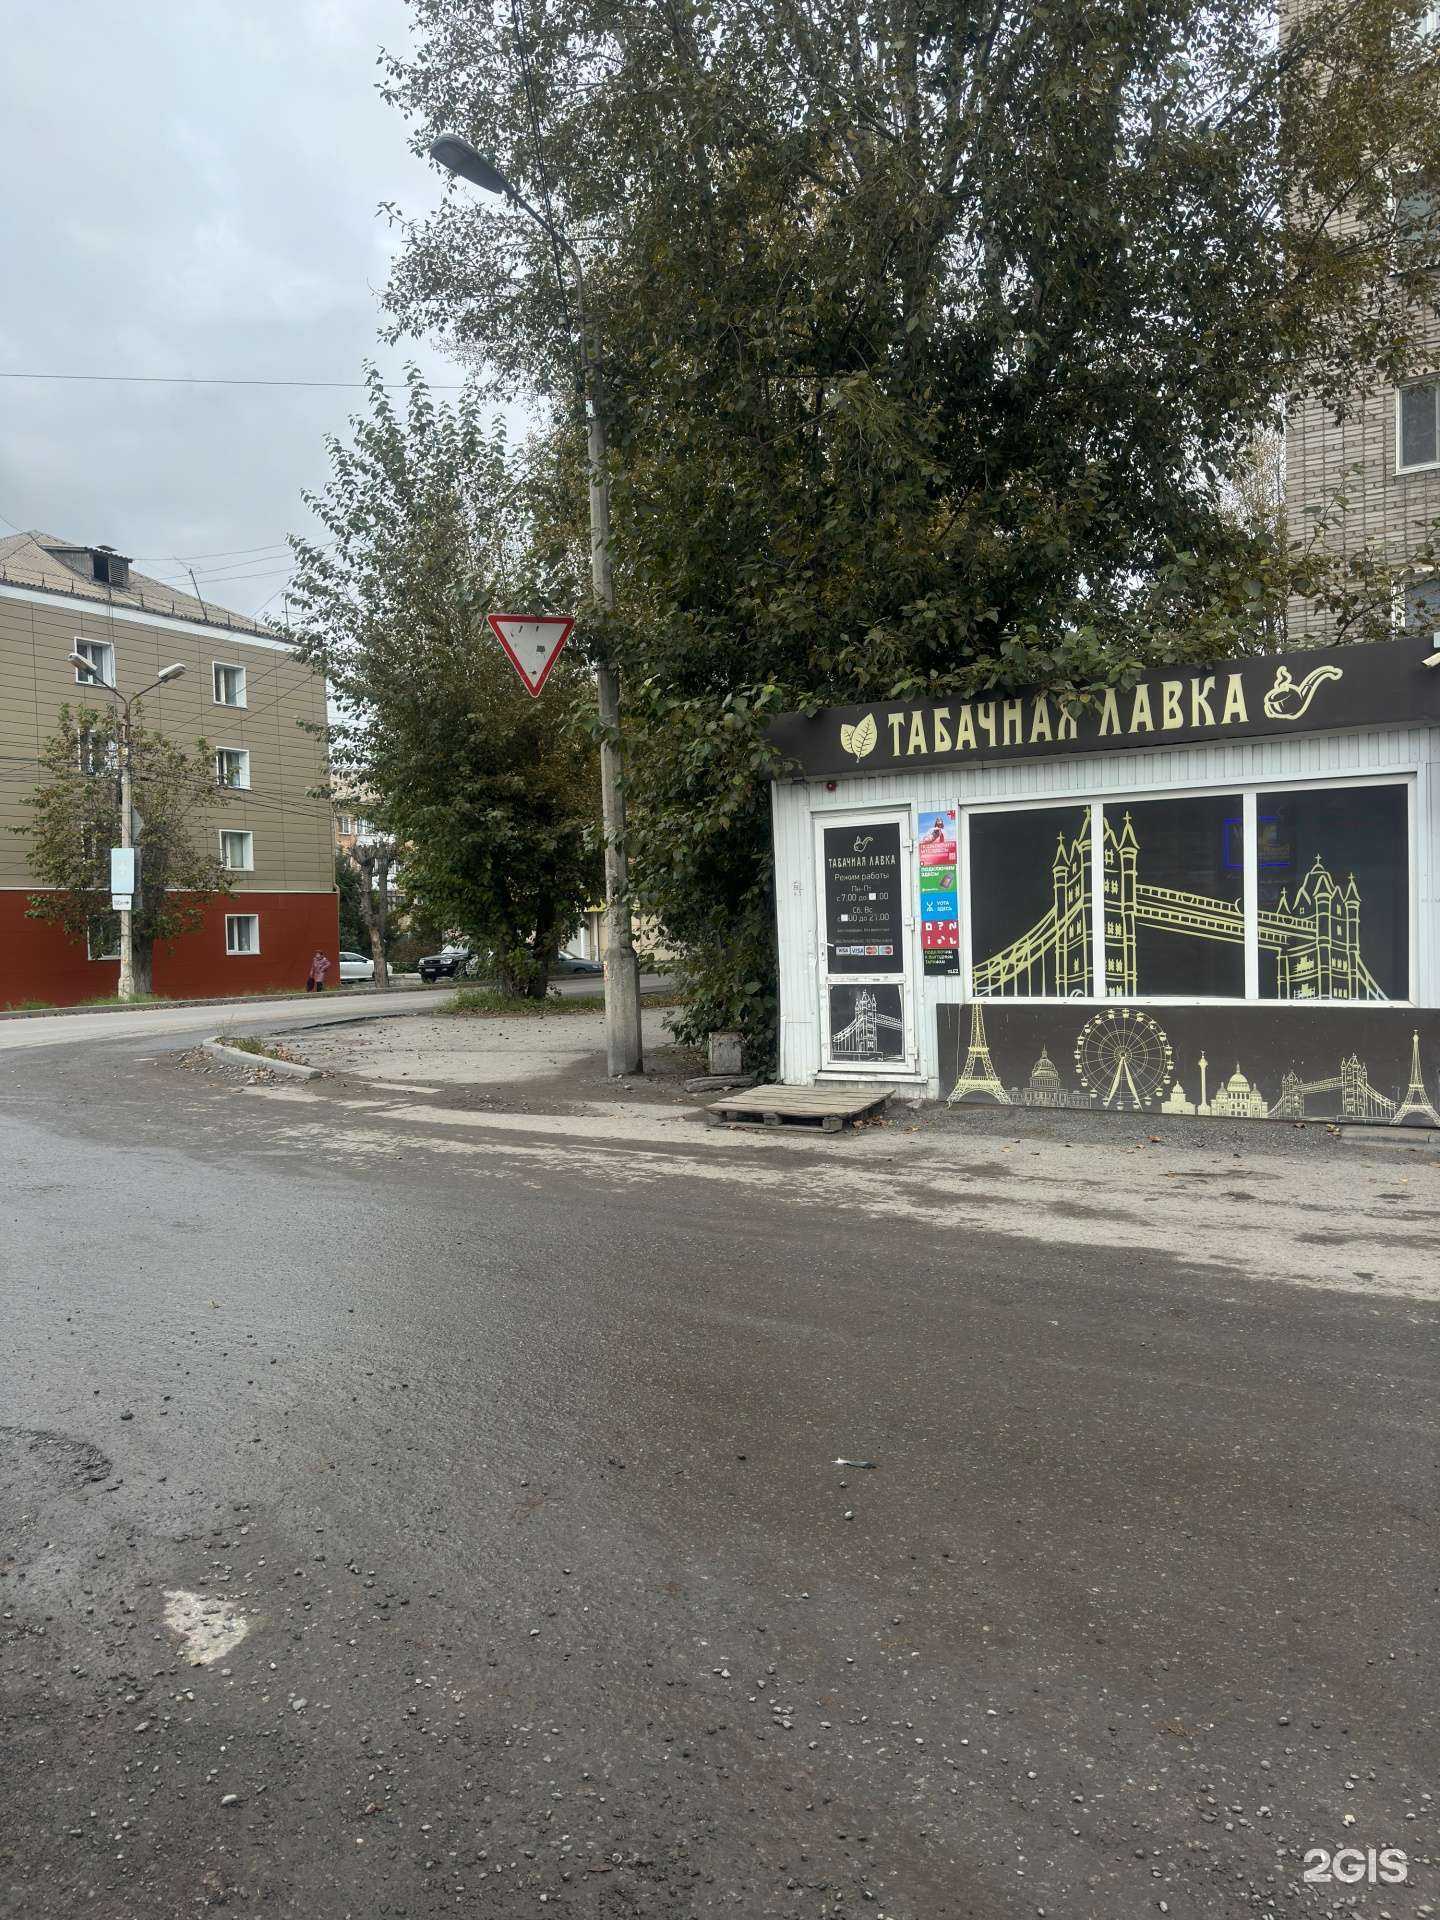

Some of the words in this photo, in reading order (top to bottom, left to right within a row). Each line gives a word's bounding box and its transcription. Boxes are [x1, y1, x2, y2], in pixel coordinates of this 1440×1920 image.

[1099, 674, 1250, 737] ЛАВКА
[828, 856, 866, 868] ТАБАЧНАЯ
[869, 855, 896, 866] ЛАВКА
[834, 873, 860, 881] Режим
[861, 872, 890, 881] работы
